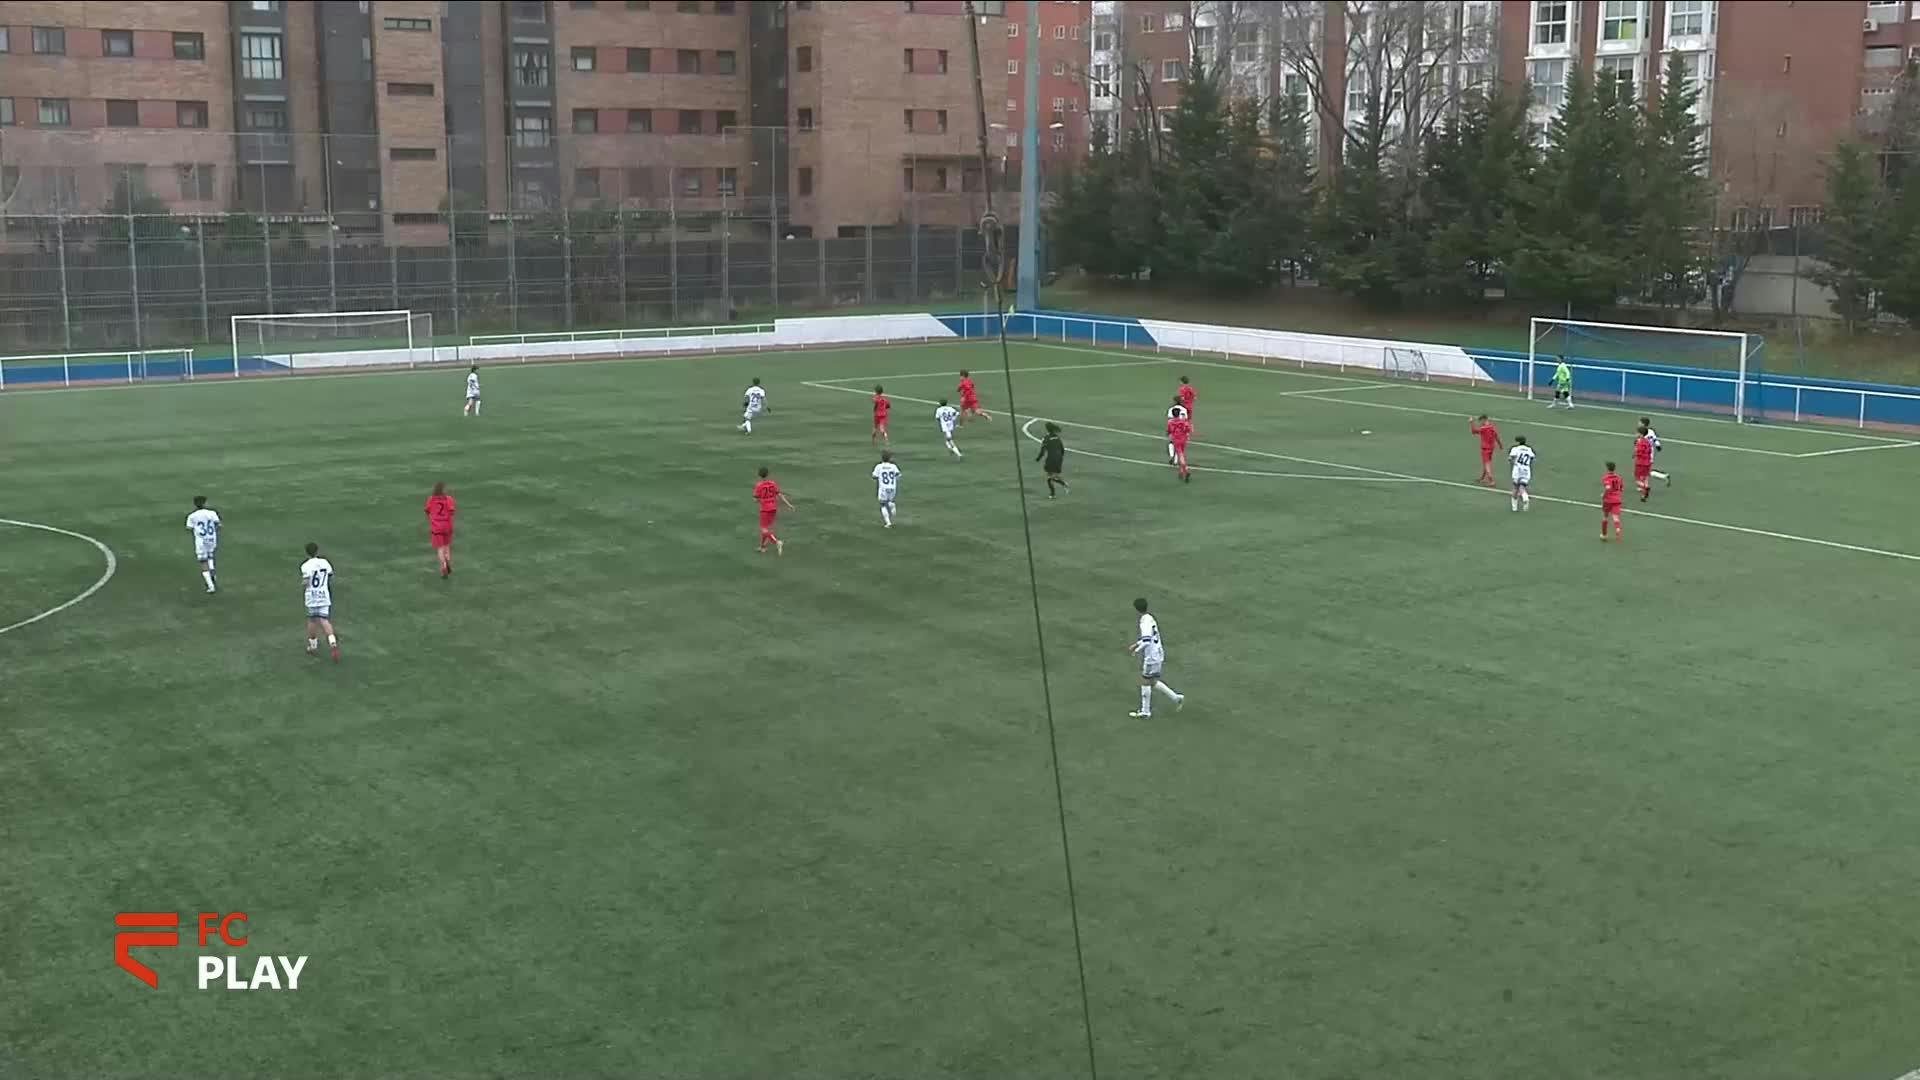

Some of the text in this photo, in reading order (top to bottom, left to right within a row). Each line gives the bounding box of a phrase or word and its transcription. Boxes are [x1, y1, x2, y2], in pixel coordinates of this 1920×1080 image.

[1517, 452, 1530, 466] 42
[881, 471, 895, 485] 89
[197, 519, 214, 537] 36
[312, 568, 327, 588] 67
